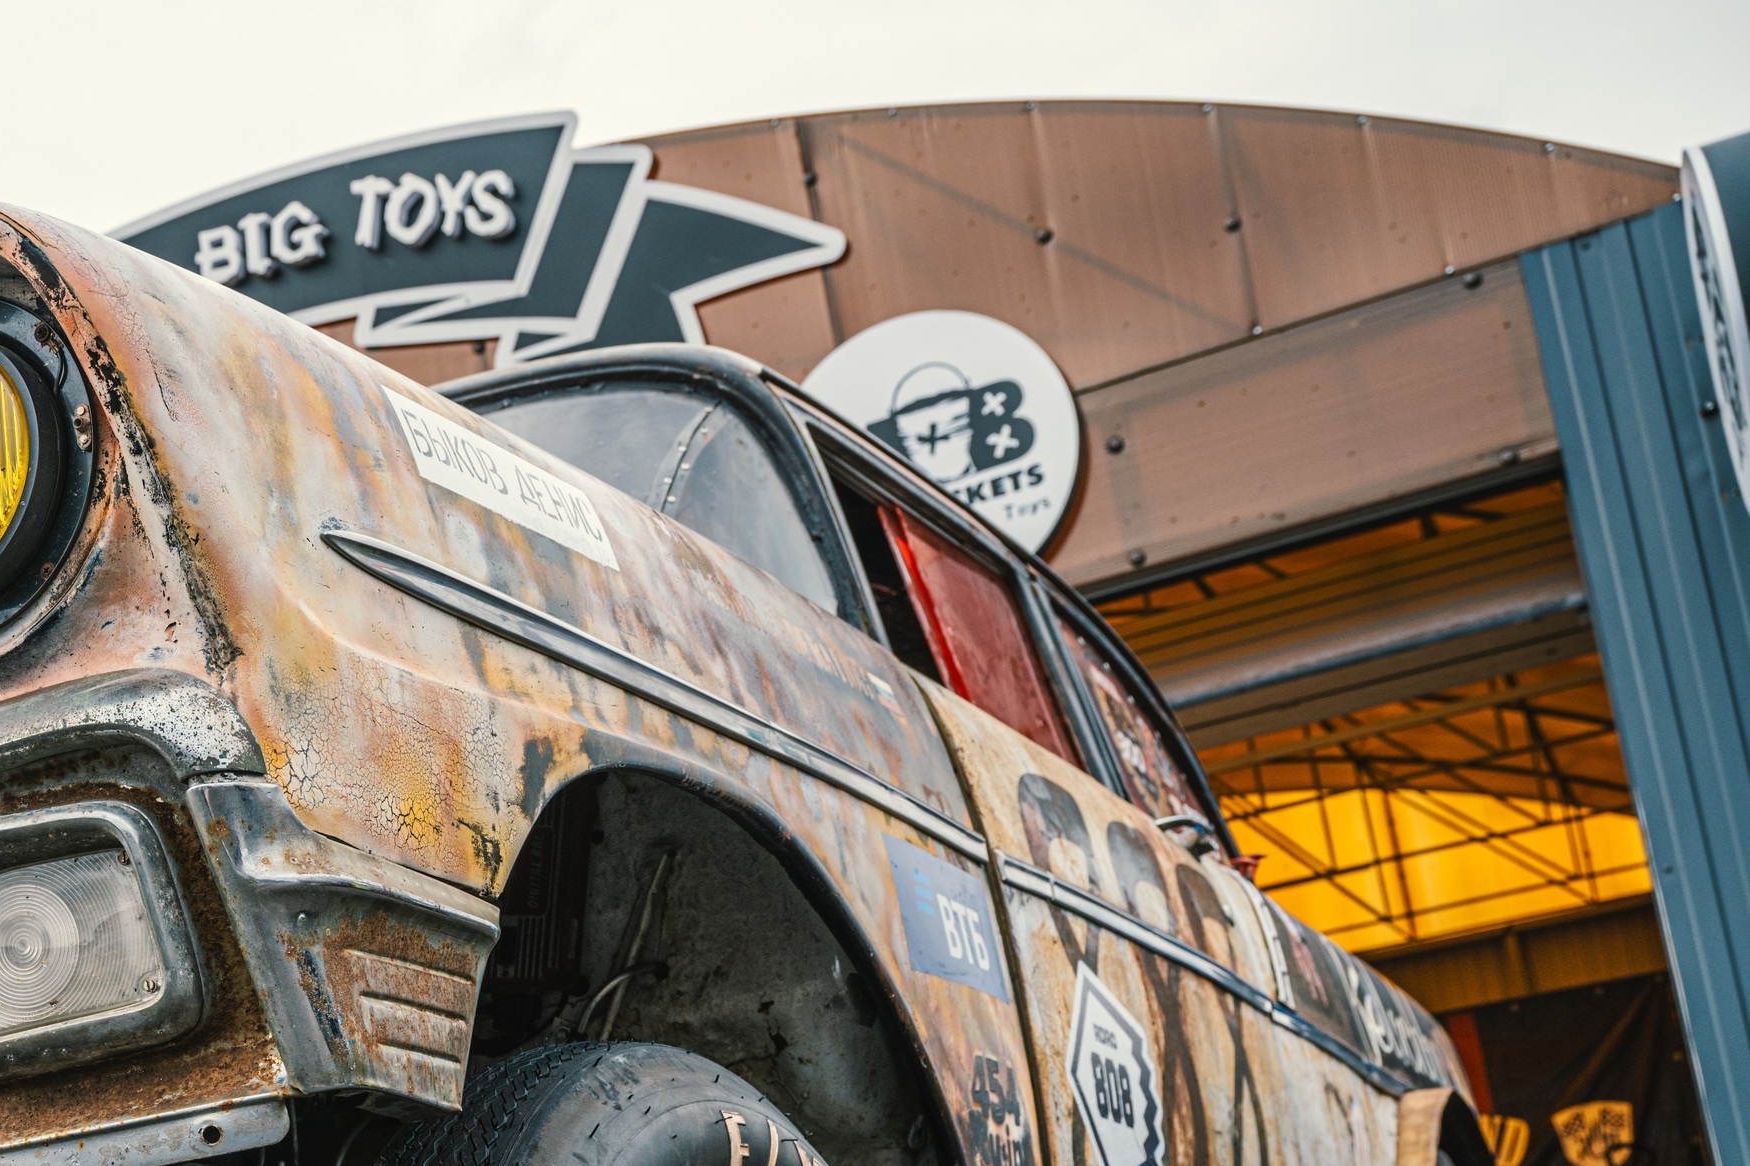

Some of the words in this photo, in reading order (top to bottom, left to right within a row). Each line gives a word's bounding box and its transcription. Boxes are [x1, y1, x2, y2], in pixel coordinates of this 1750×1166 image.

[194, 200, 330, 288] BIG
[350, 169, 517, 250] TOYS
[400, 408, 508, 496] БЫКОВ
[514, 464, 604, 543] ДЕНИС
[936, 893, 991, 972] ВТБ
[971, 1054, 1021, 1126] 454
[1091, 1052, 1135, 1129] 808
